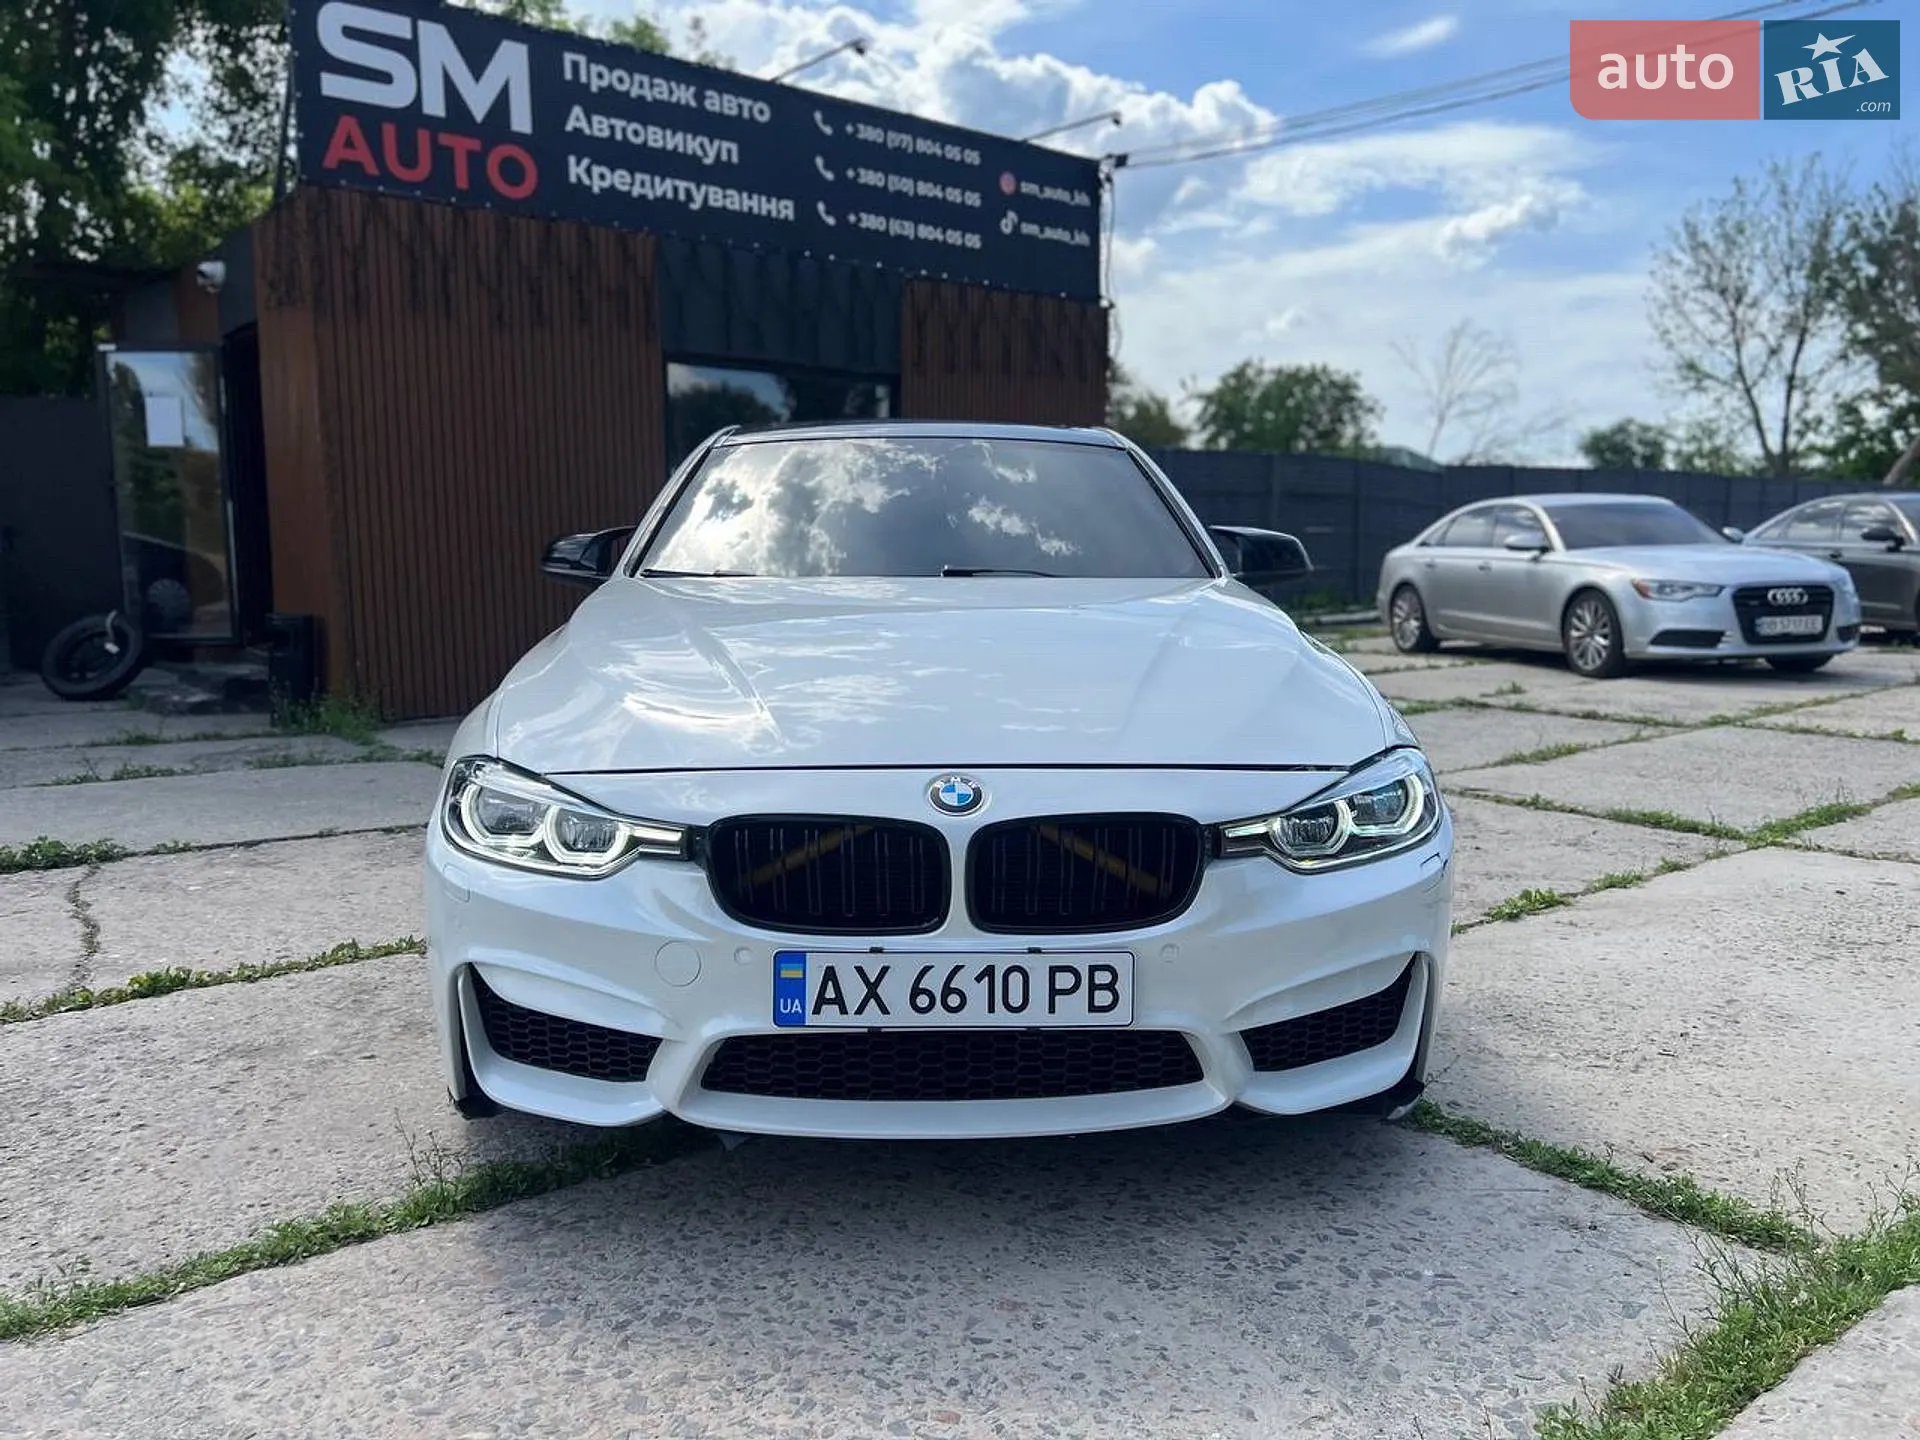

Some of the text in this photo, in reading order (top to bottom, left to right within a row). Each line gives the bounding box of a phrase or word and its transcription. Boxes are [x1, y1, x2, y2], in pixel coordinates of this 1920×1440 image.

[316, 1, 533, 135] SM
[562, 51, 771, 123] Продаж авто
[322, 114, 538, 199] AUTO
[565, 105, 739, 165] Автовикуп
[943, 144, 962, 163] 05
[963, 148, 982, 166] 05
[567, 154, 796, 222] Кредитування
[944, 186, 963, 205] 05
[963, 190, 983, 208] 05
[945, 229, 963, 246] 05
[963, 232, 982, 250] 05
[780, 1000, 802, 1014] UA
[811, 964, 1120, 1015] AX 6610 PB
